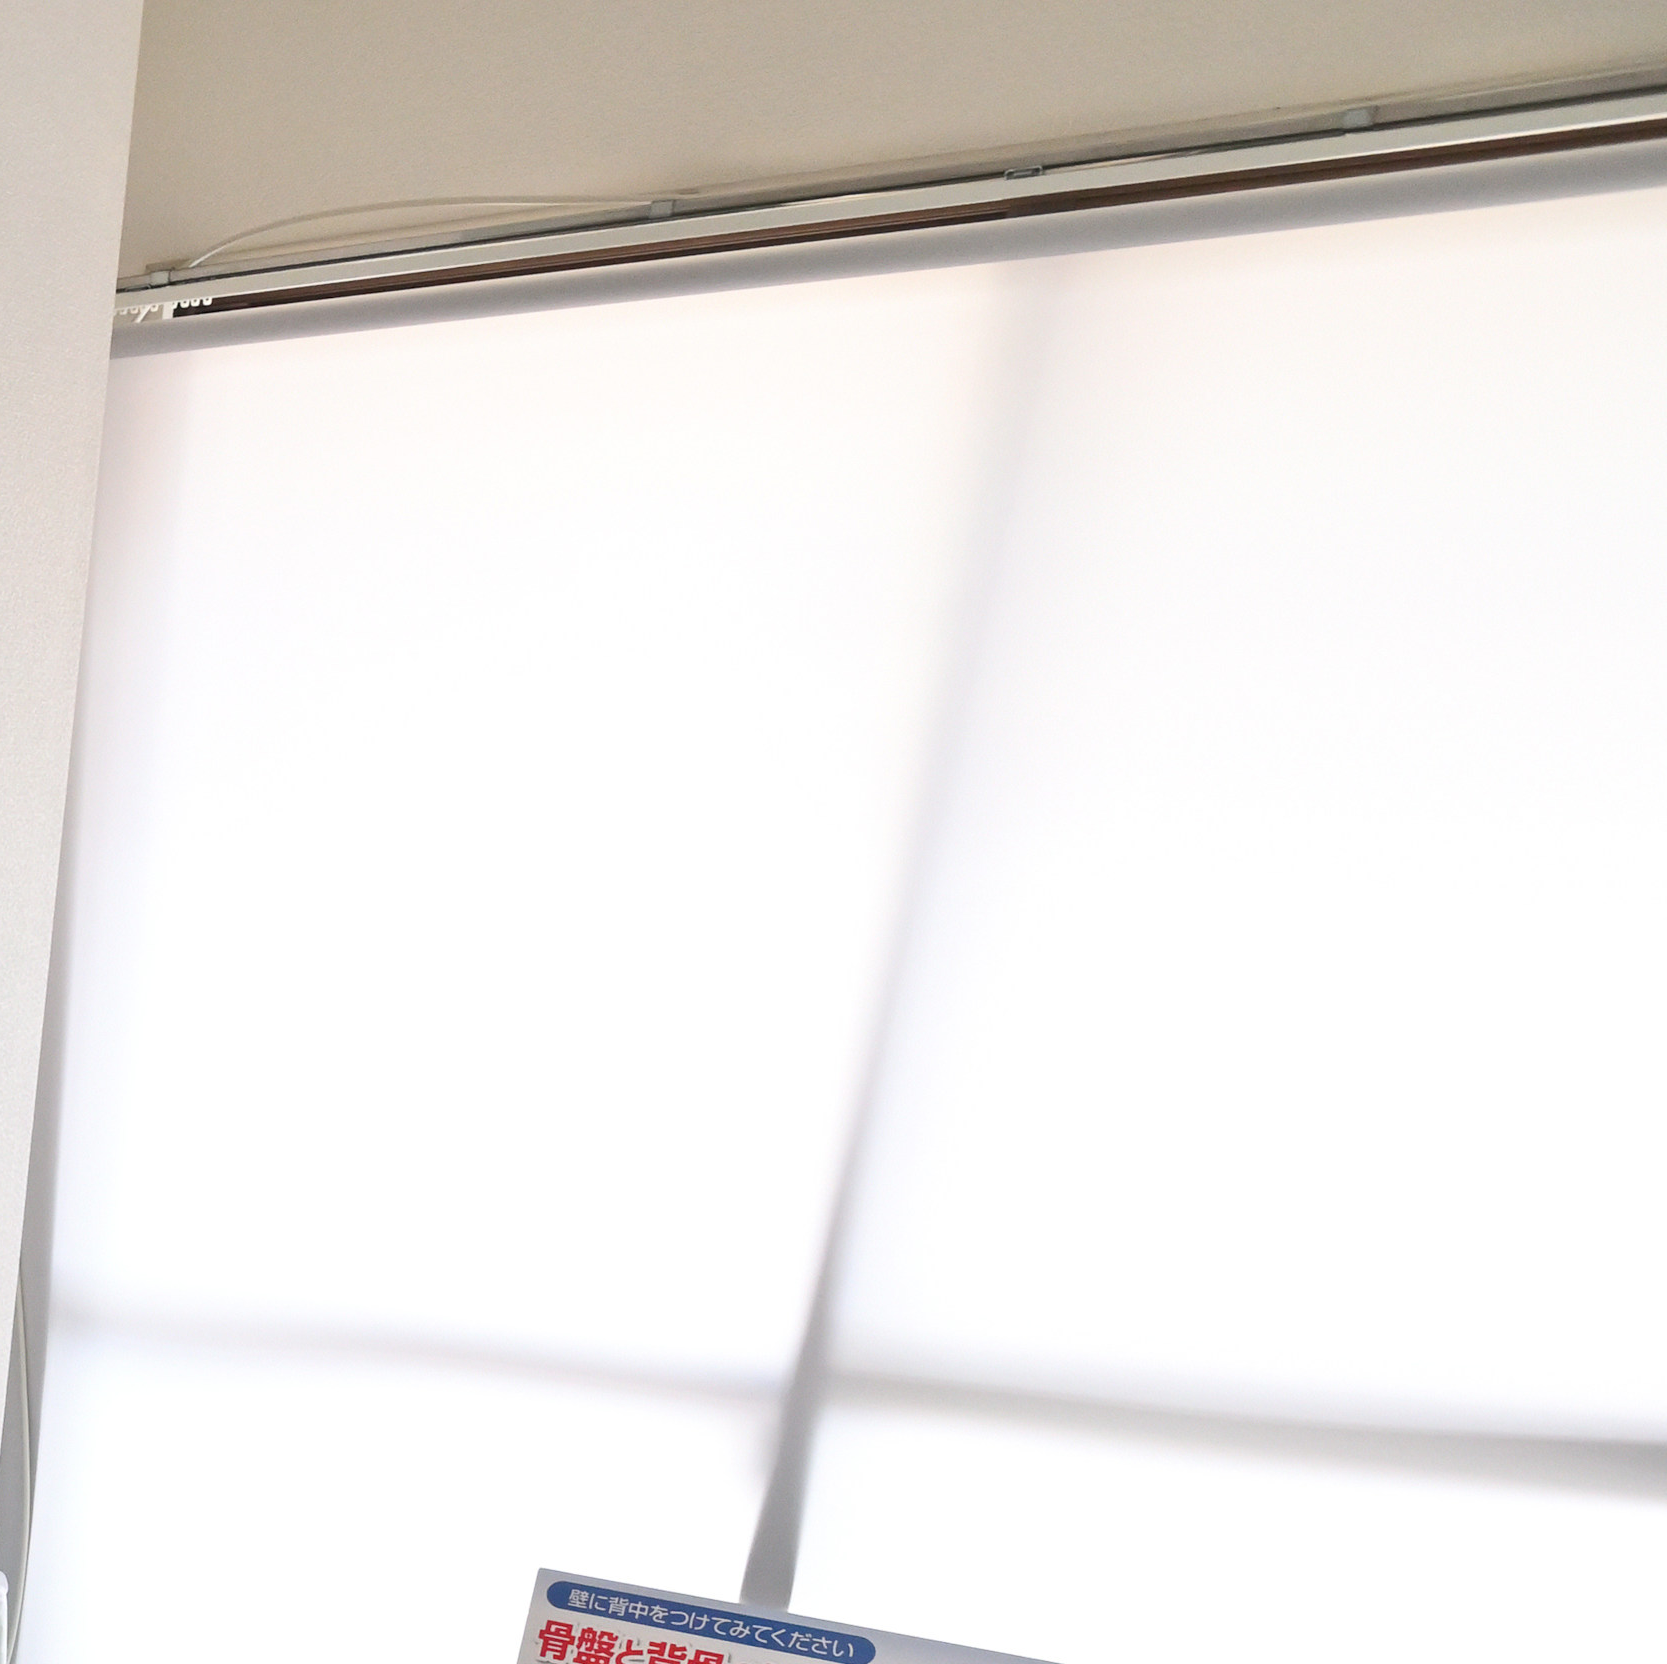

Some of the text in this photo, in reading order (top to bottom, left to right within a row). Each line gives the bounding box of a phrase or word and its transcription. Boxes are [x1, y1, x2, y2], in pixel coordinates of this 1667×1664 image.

[568, 1588, 855, 1659] 壁に背中をつけてみてください
